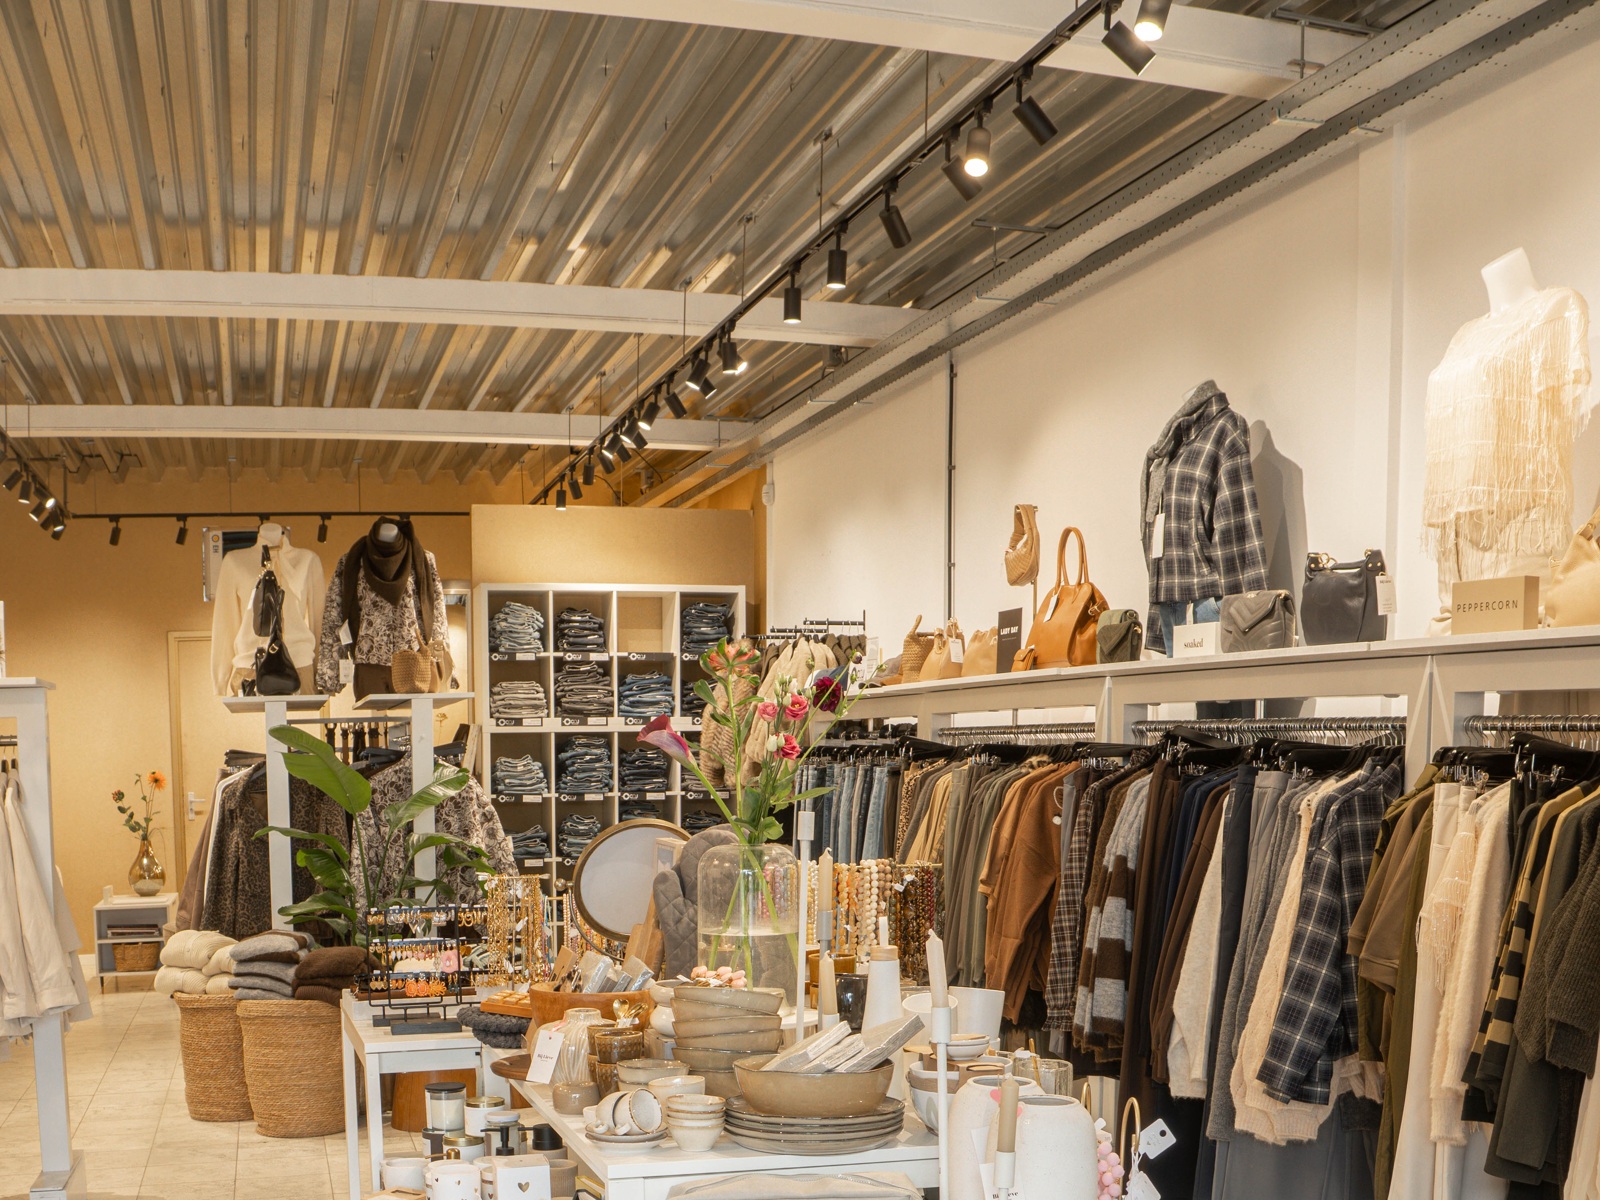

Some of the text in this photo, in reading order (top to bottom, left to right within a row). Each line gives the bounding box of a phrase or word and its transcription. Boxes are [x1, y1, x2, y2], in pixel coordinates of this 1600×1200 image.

[1456, 599, 1519, 613] PEPPERCORN
[1000, 625, 1019, 636] LADY DAY
[1183, 637, 1204, 649] soaked
